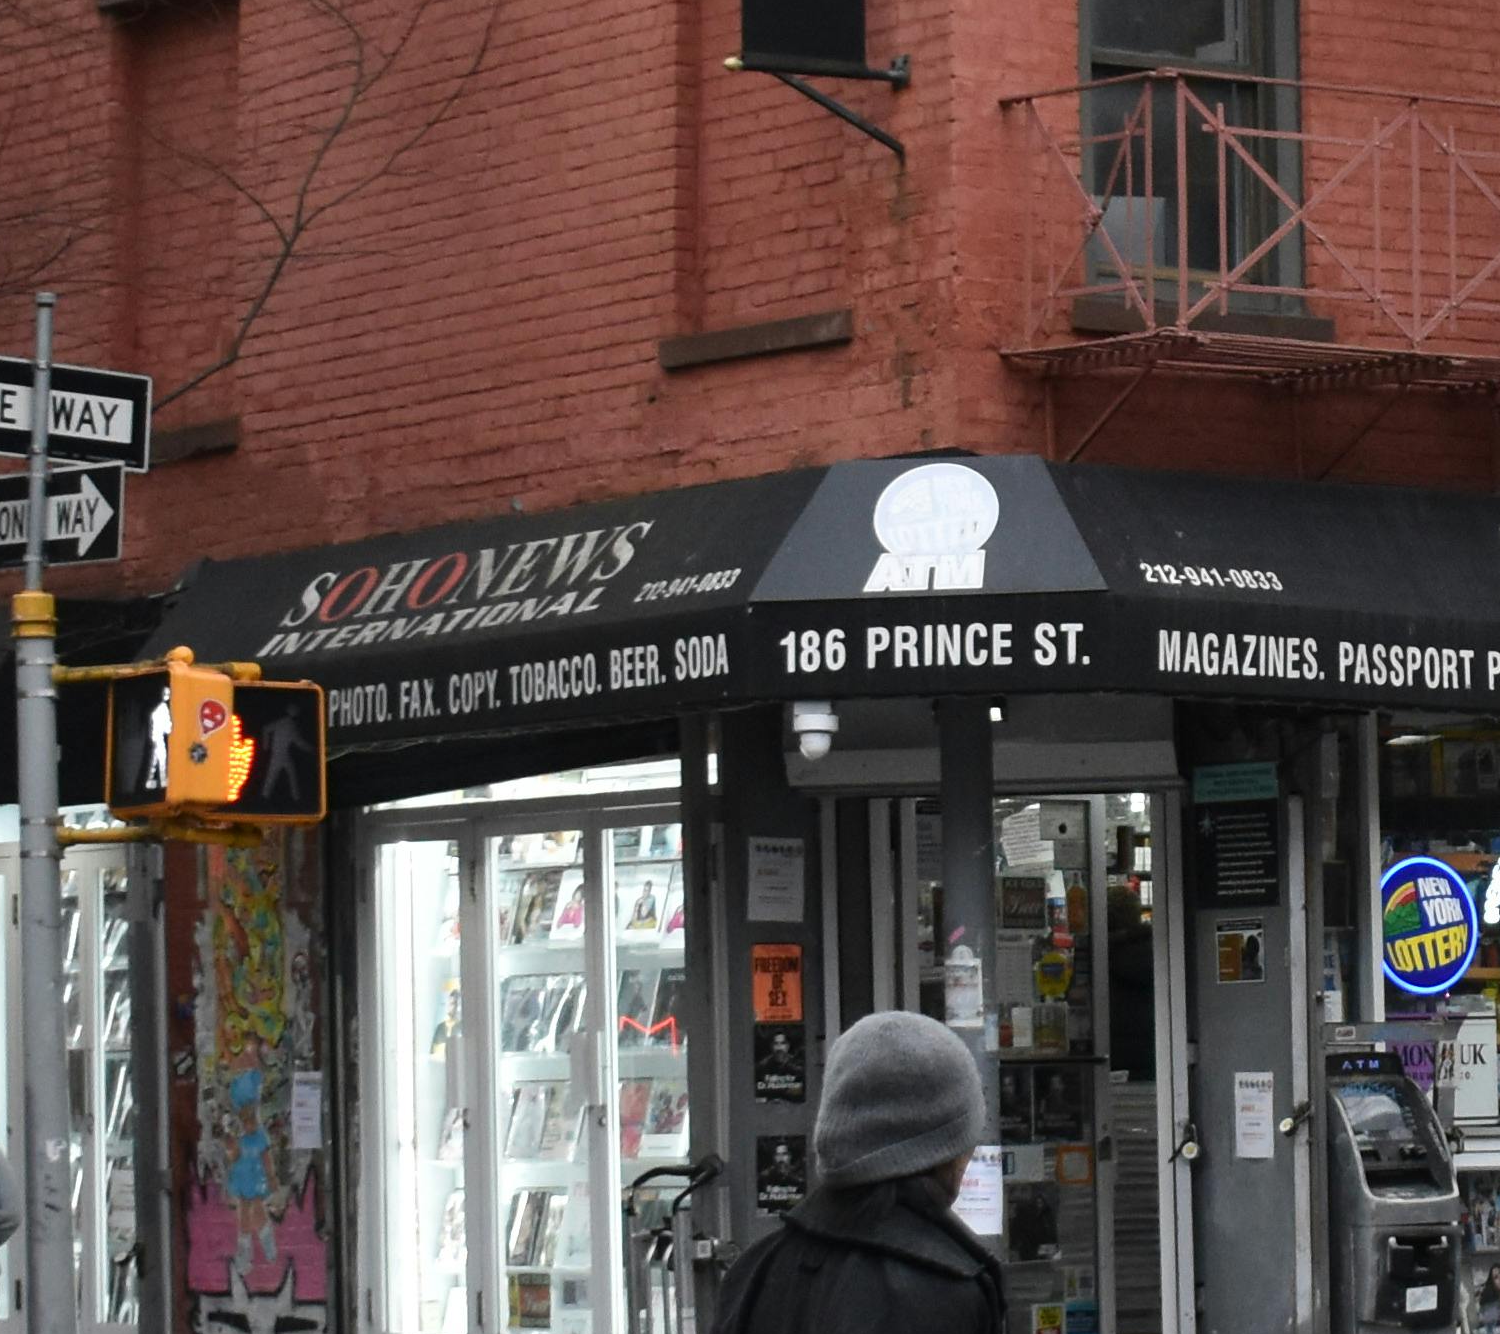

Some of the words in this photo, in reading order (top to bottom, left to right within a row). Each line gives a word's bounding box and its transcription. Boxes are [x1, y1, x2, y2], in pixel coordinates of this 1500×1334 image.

[52, 395, 119, 436] WAY
[56, 498, 99, 535] WAY
[633, 567, 742, 604] 212-941-0833
[863, 549, 986, 592] ATM
[1139, 561, 1283, 592] 212-941-0833
[256, 586, 605, 658] INTERNATIONAL
[779, 628, 847, 673] 186
[866, 622, 1013, 668] PRINCE
[1033, 622, 1091, 667] ST.
[1158, 629, 1325, 681] MAGAZINES.
[1338, 641, 1475, 691] PASSPORT
[329, 682, 392, 728] PHOTO.
[400, 676, 441, 720] FAX.
[449, 668, 500, 715] COPY.
[509, 655, 601, 706] TOBACCO.
[609, 643, 667, 693] BEER.
[674, 633, 729, 682] SODA
[1417, 876, 1452, 898] NEW
[1422, 897, 1464, 927] YORK
[754, 956, 799, 972] FREEDOM
[1386, 923, 1468, 972] LOTTERY
[768, 991, 788, 1007] SEX
[772, 974, 785, 989] OF
[1342, 1059, 1381, 1070] ATM
[1393, 1043, 1487, 1066] MONUK
